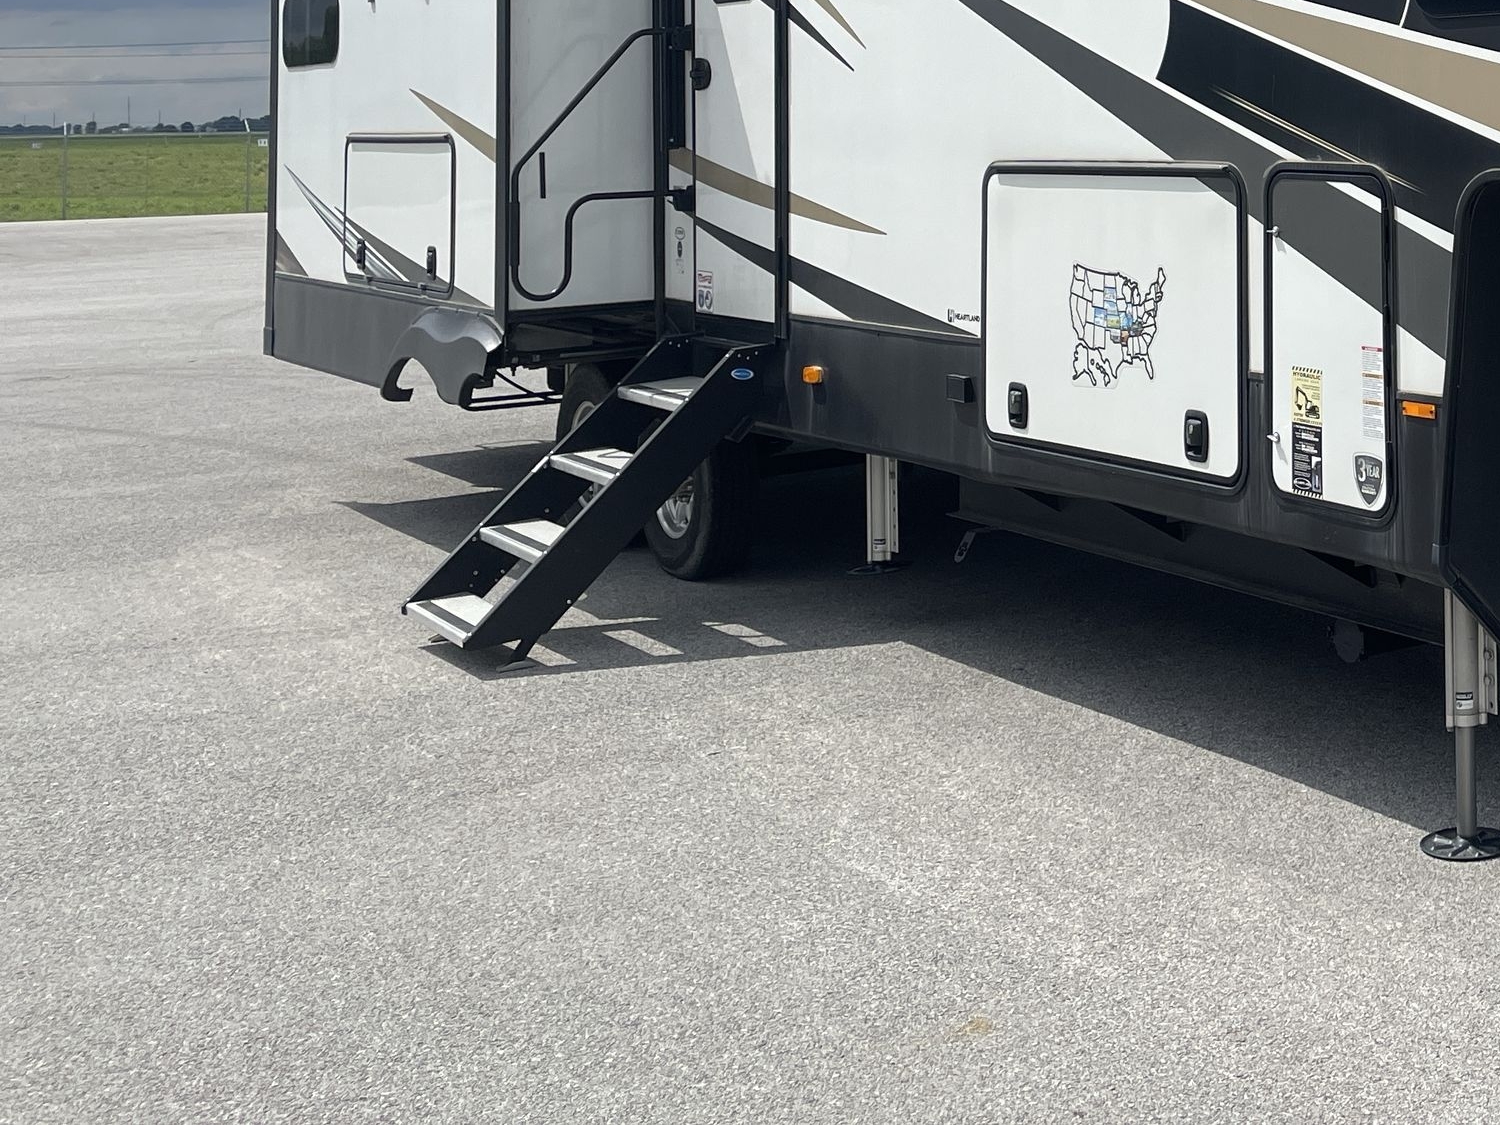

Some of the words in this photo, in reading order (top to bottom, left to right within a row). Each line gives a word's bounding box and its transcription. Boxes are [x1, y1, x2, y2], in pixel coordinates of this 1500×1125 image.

[1293, 371, 1321, 381] HYDRAULIC
[1357, 458, 1366, 482] 3
[1366, 464, 1380, 479] YEAR
